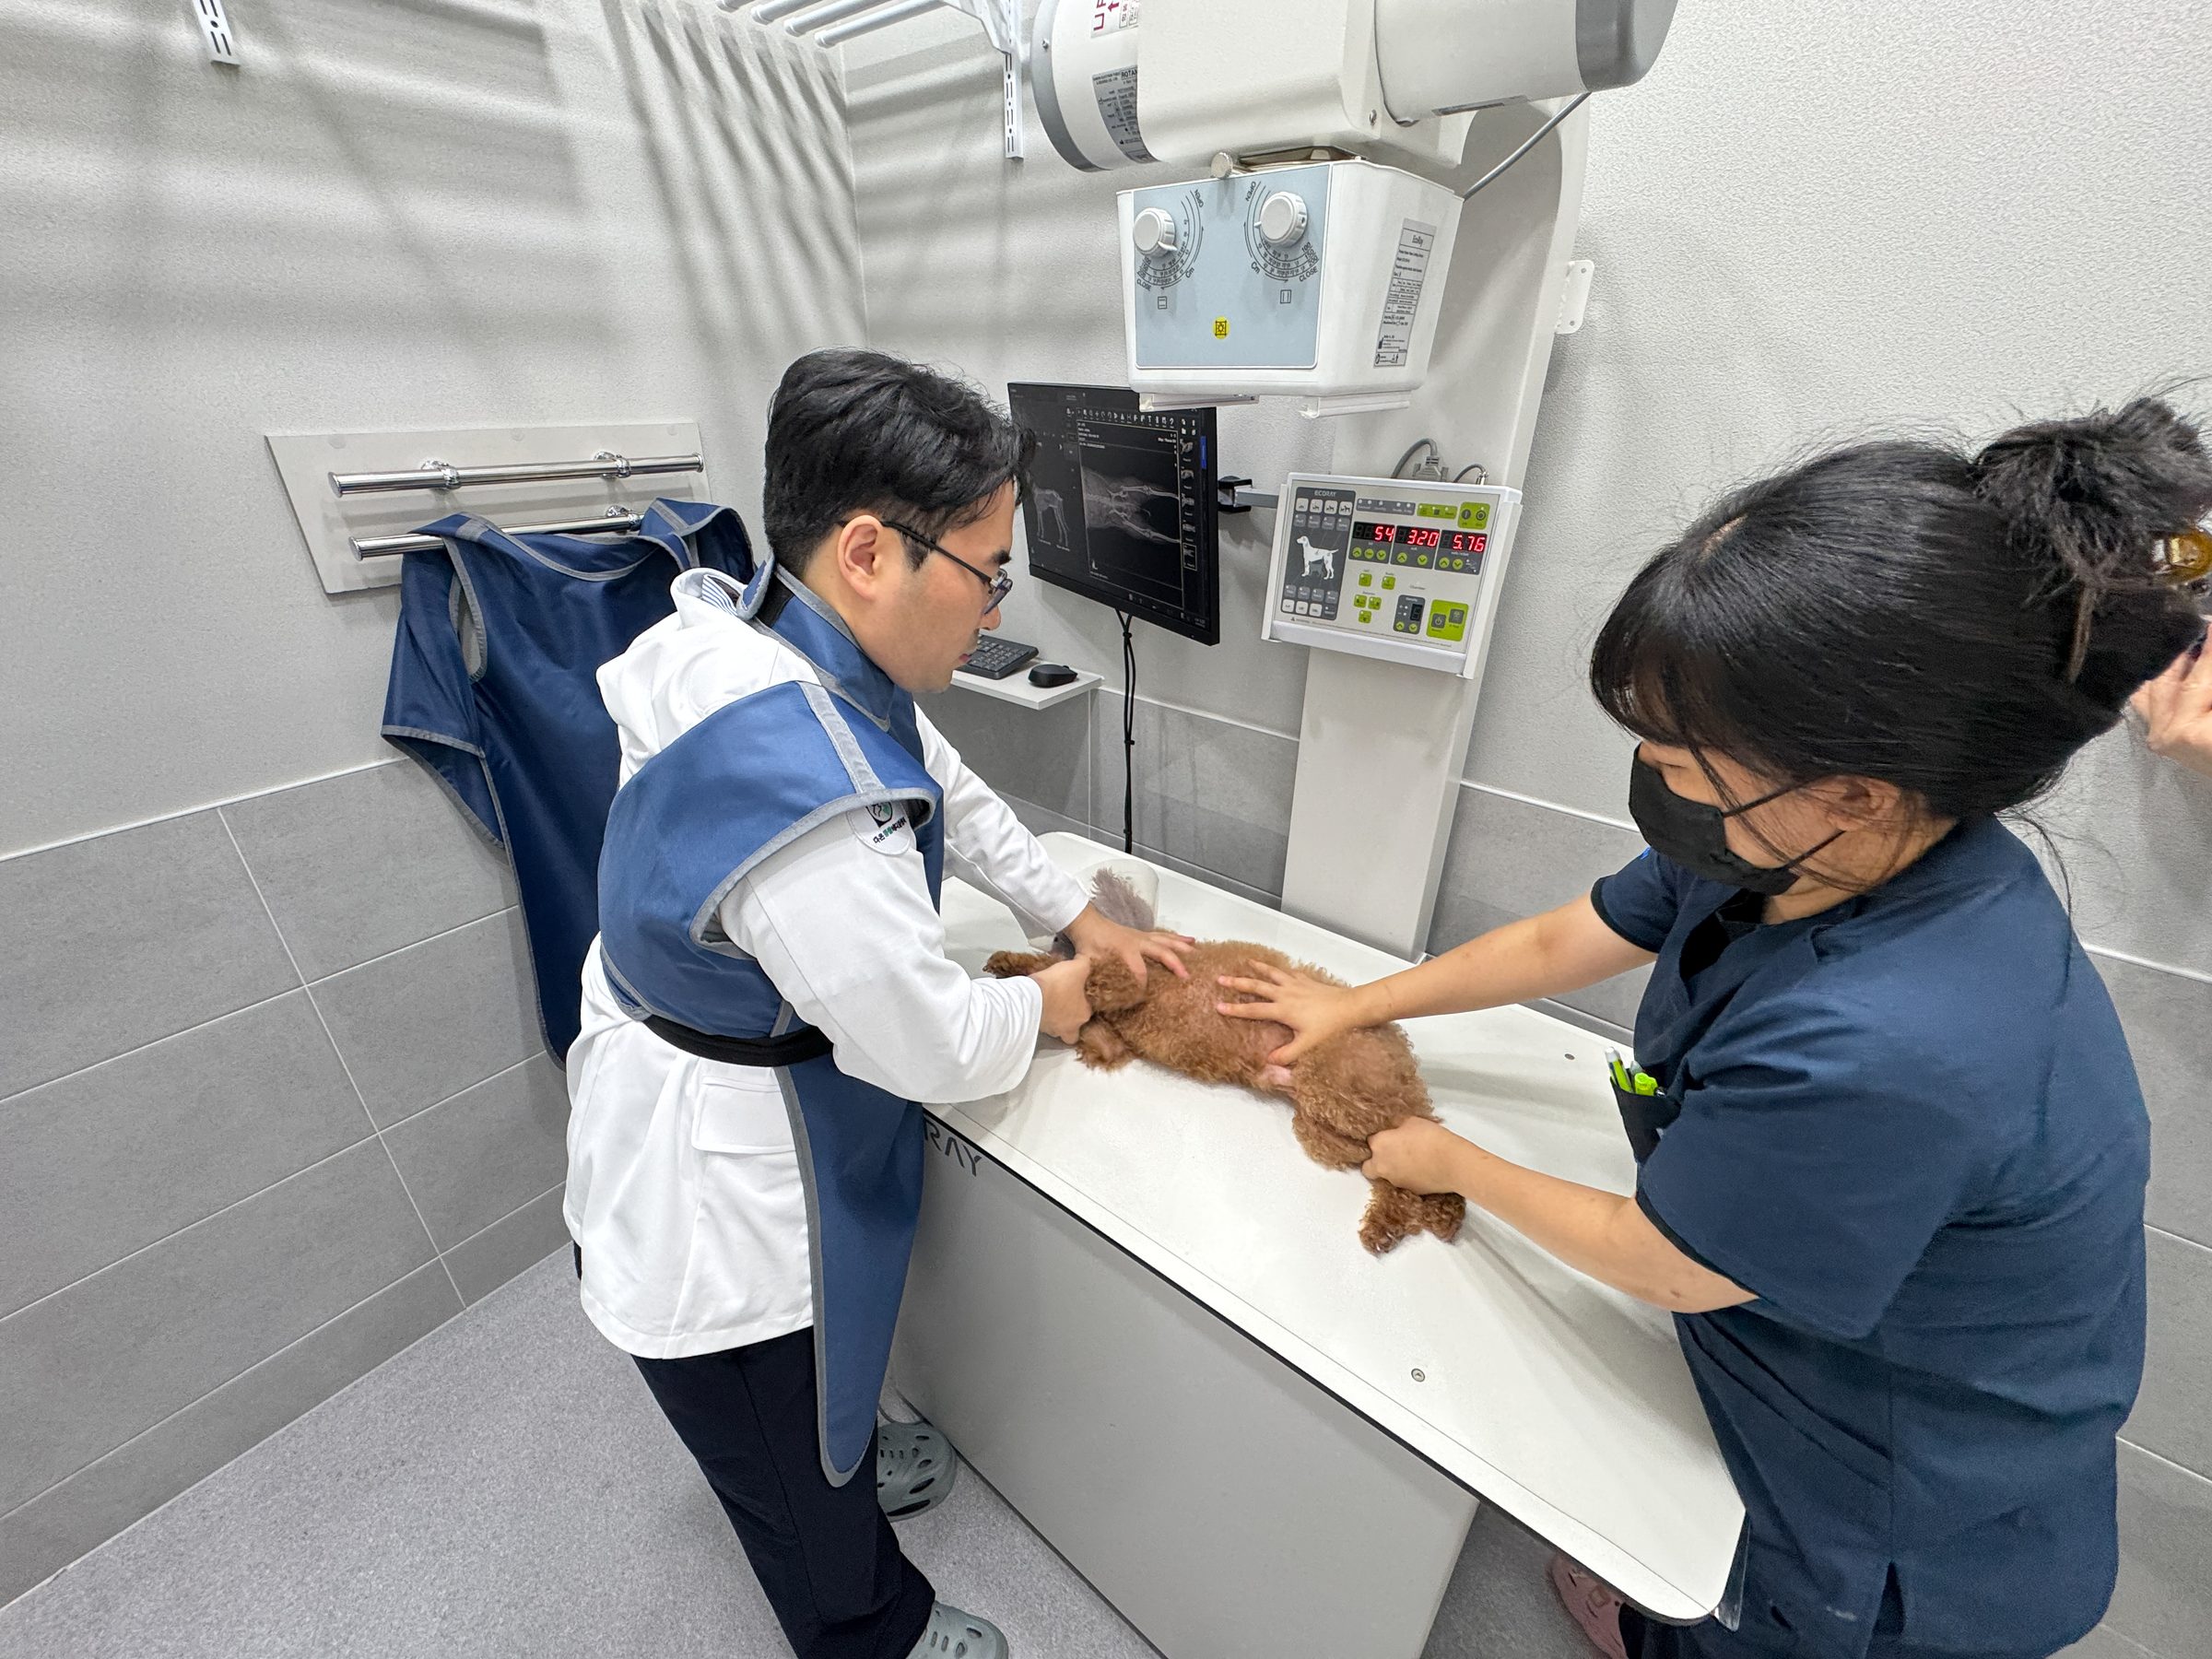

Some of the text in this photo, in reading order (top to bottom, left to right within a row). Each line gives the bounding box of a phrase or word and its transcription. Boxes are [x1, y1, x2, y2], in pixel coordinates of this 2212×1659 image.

[1299, 265, 1318, 282] CLOSE
[1313, 489, 1337, 498] ECORAY
[1374, 525, 1394, 542] 54
[1406, 529, 1439, 547] 320
[1453, 534, 1486, 552] 5.76
